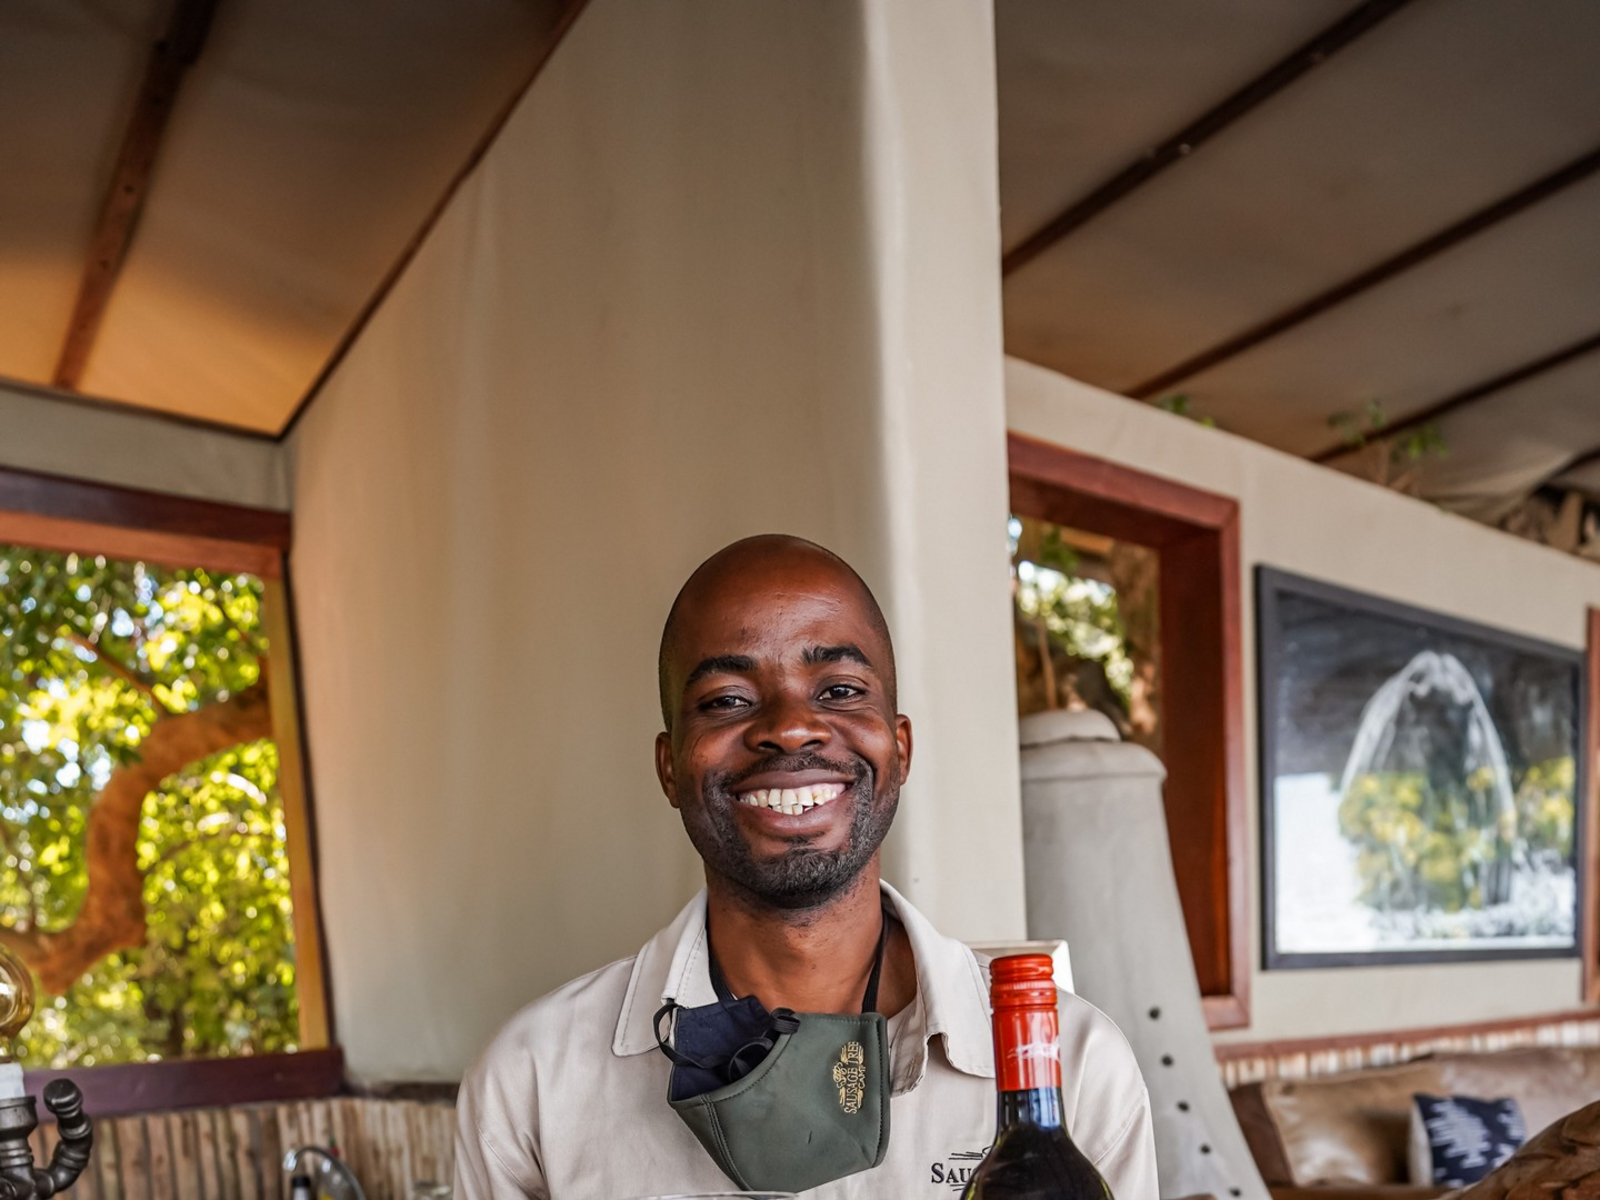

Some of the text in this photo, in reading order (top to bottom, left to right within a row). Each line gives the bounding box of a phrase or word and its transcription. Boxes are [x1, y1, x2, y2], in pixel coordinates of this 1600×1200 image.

[844, 1041, 859, 1114] SAUSAGE TREE
[931, 1162, 973, 1184] SAU
